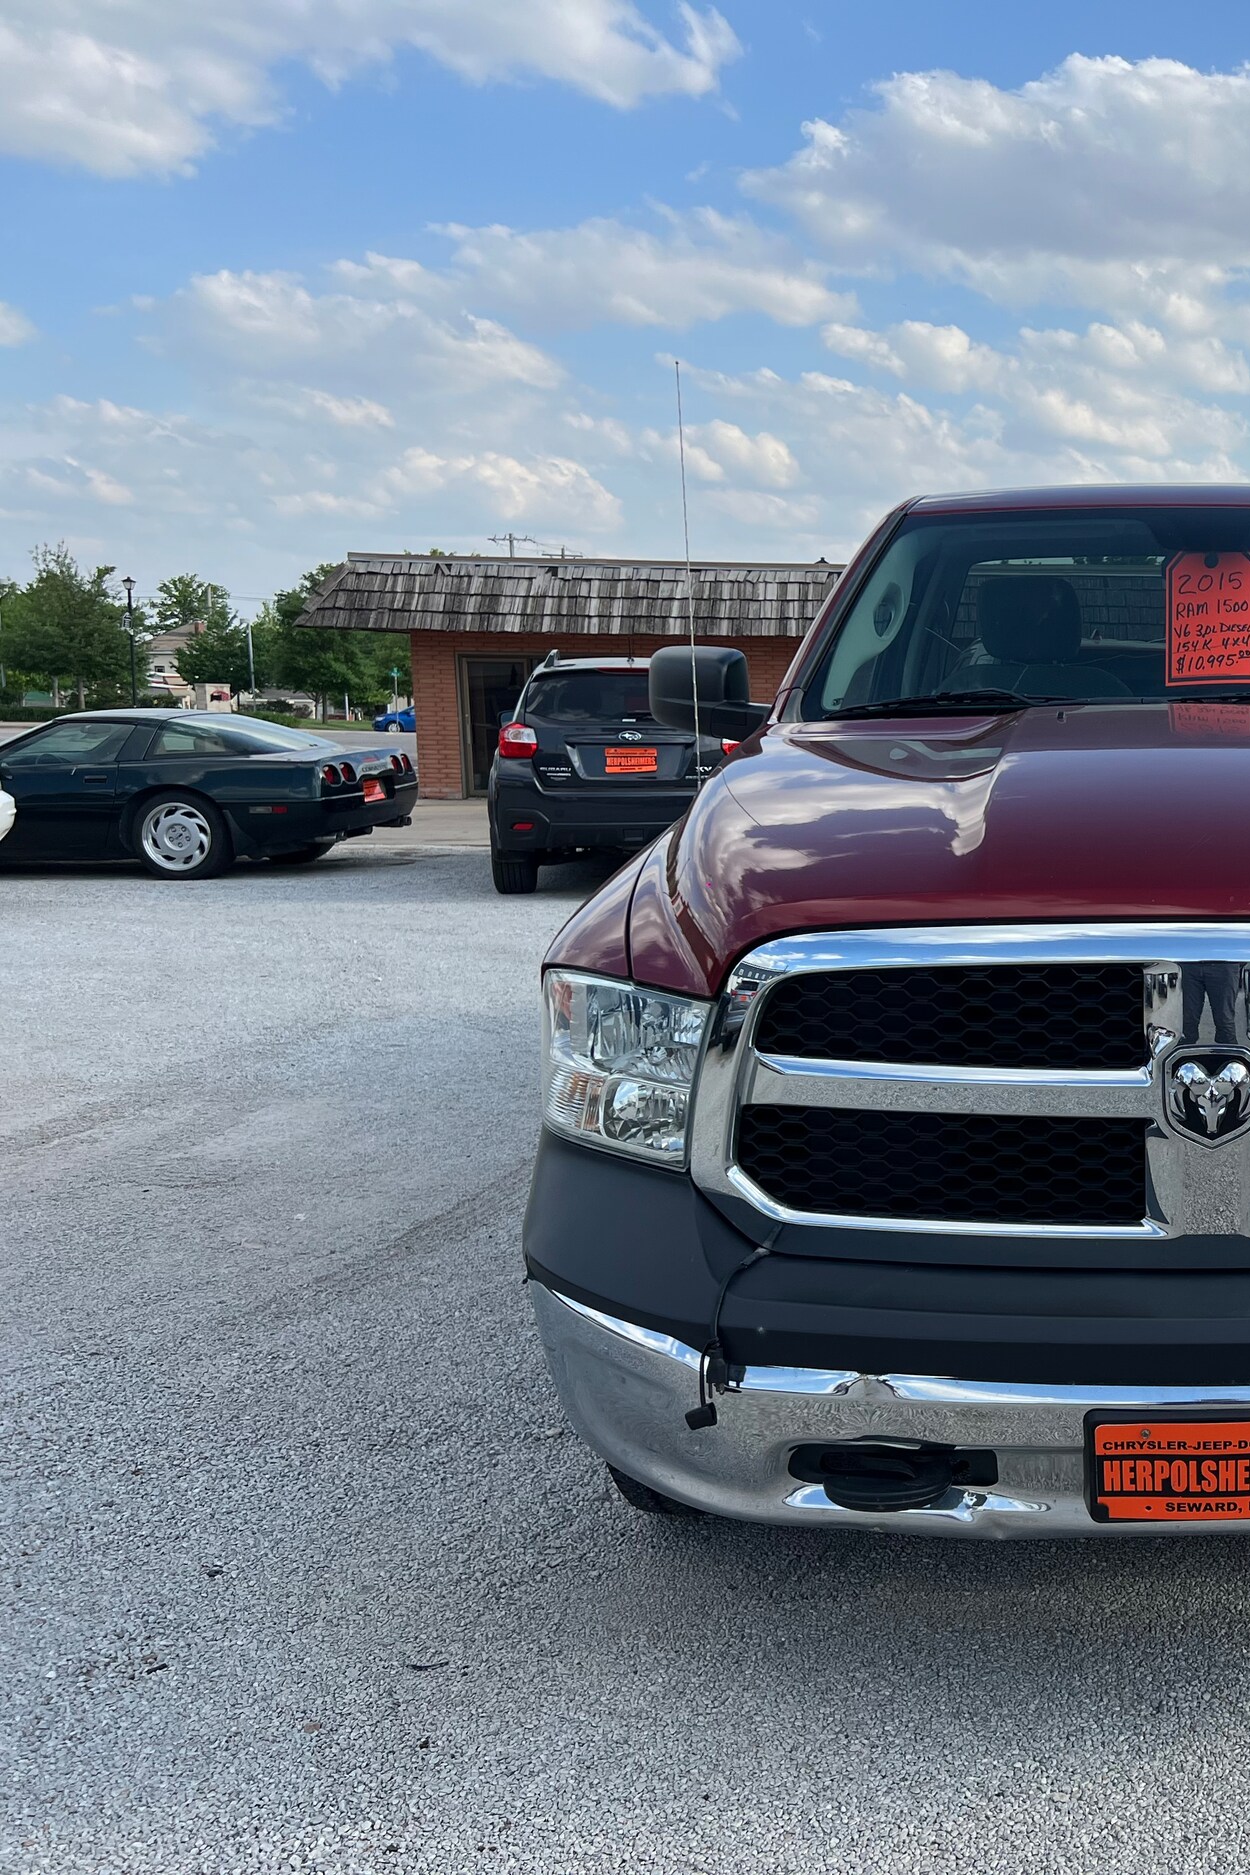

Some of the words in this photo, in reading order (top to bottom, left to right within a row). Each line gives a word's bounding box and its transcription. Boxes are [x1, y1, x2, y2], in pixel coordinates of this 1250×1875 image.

[1178, 571, 1243, 595] 2015
[1176, 602, 1209, 620] RAM
[1217, 599, 1249, 613] 1500
[1174, 624, 1191, 638] V6
[1165, 1501, 1243, 1513] SEWARD,
